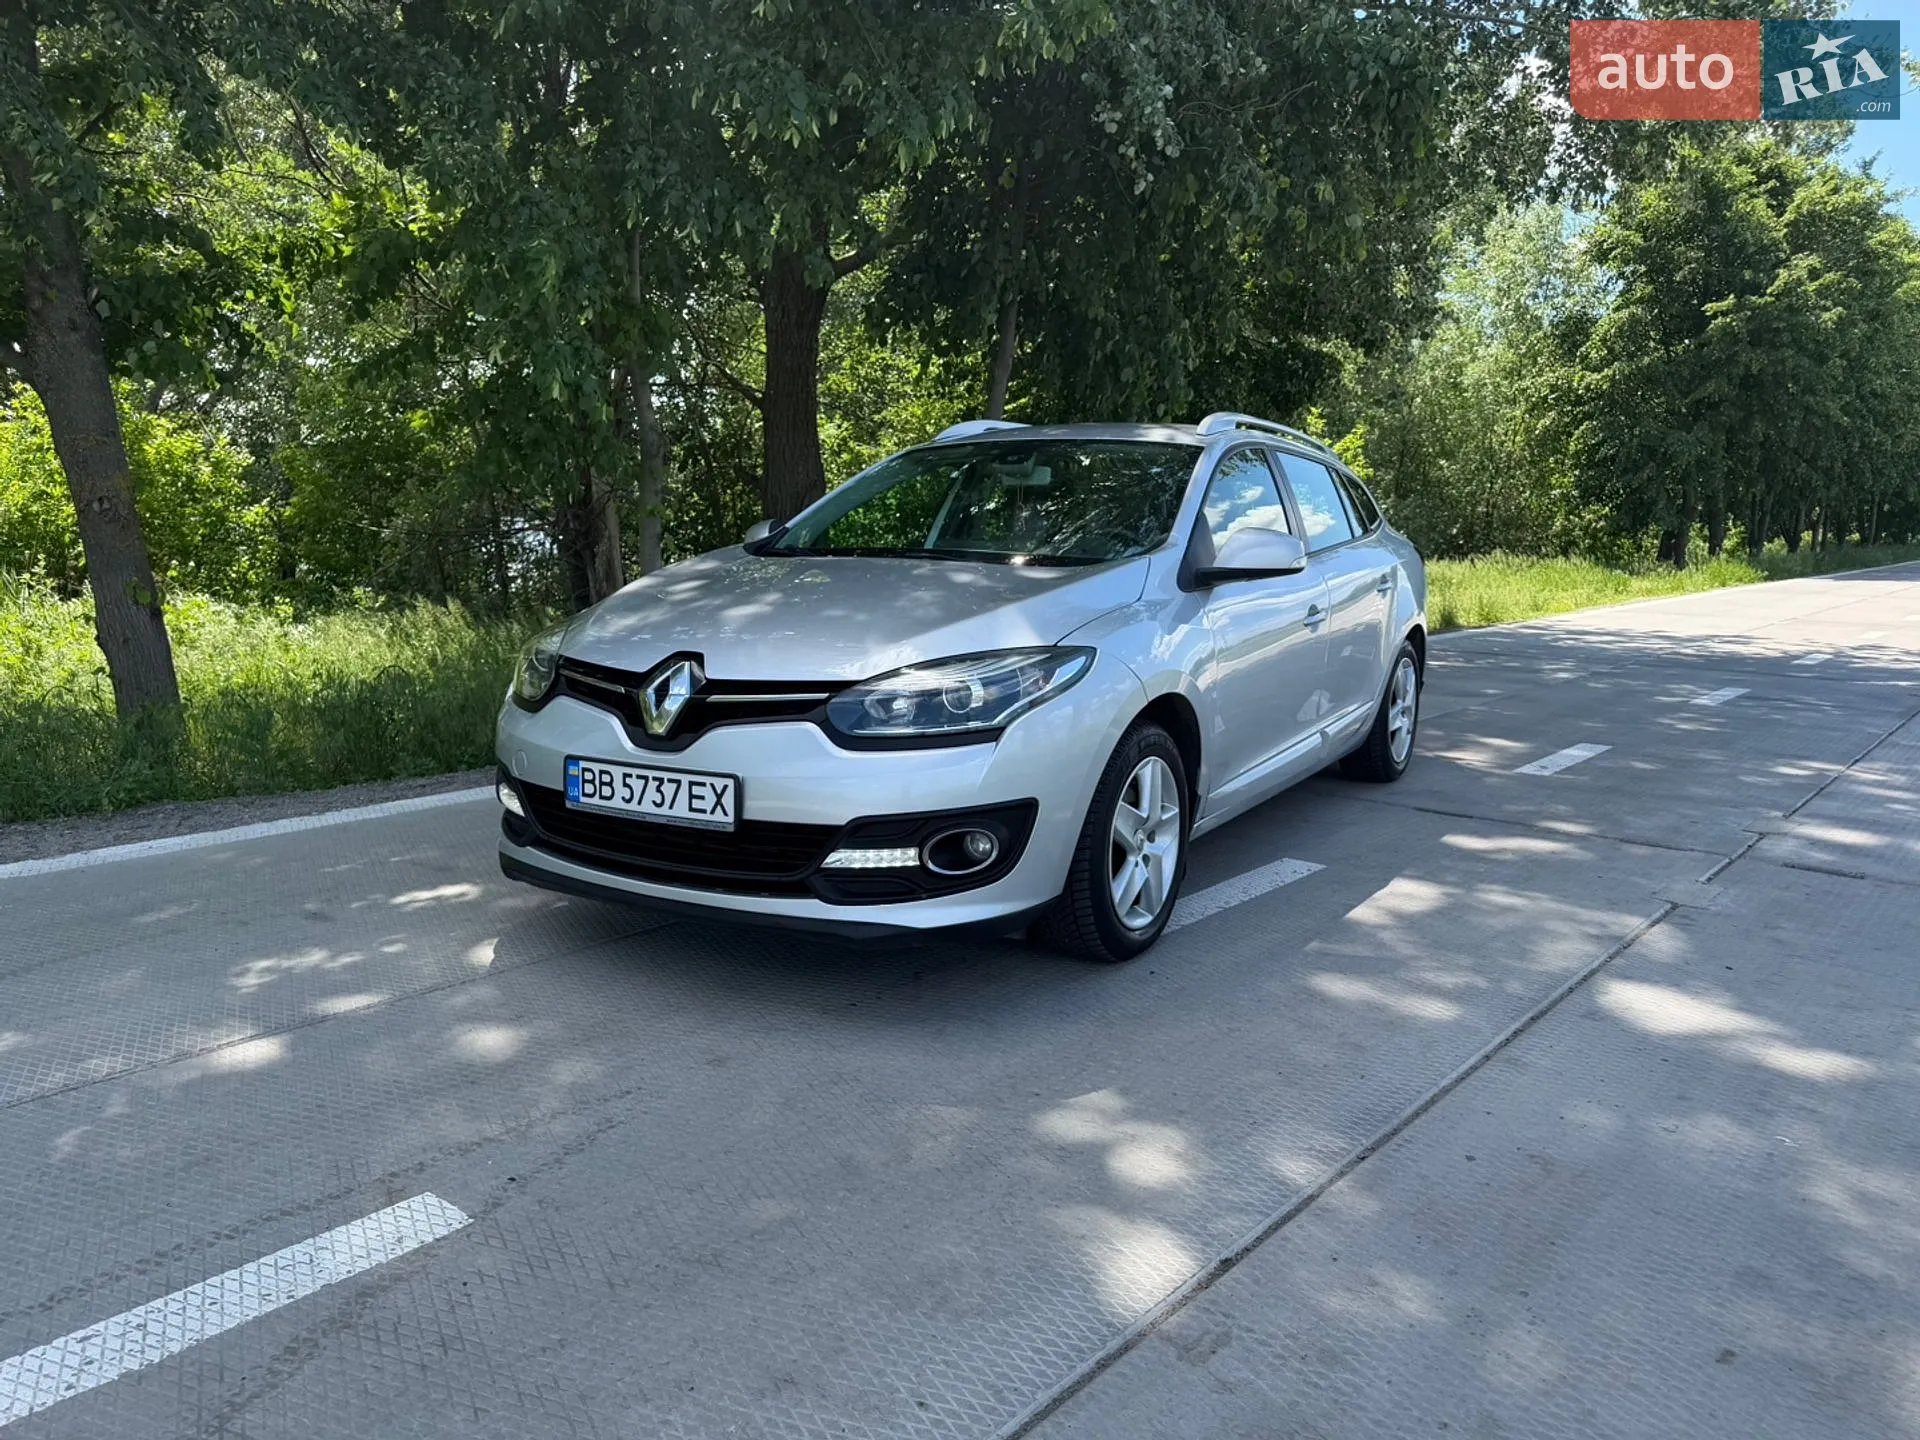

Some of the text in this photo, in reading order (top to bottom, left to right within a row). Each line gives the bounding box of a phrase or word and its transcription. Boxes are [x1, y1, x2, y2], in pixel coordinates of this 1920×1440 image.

[568, 786, 579, 797] UA
[581, 767, 615, 801] BB
[621, 772, 682, 810] 5737
[688, 780, 729, 817] EX
